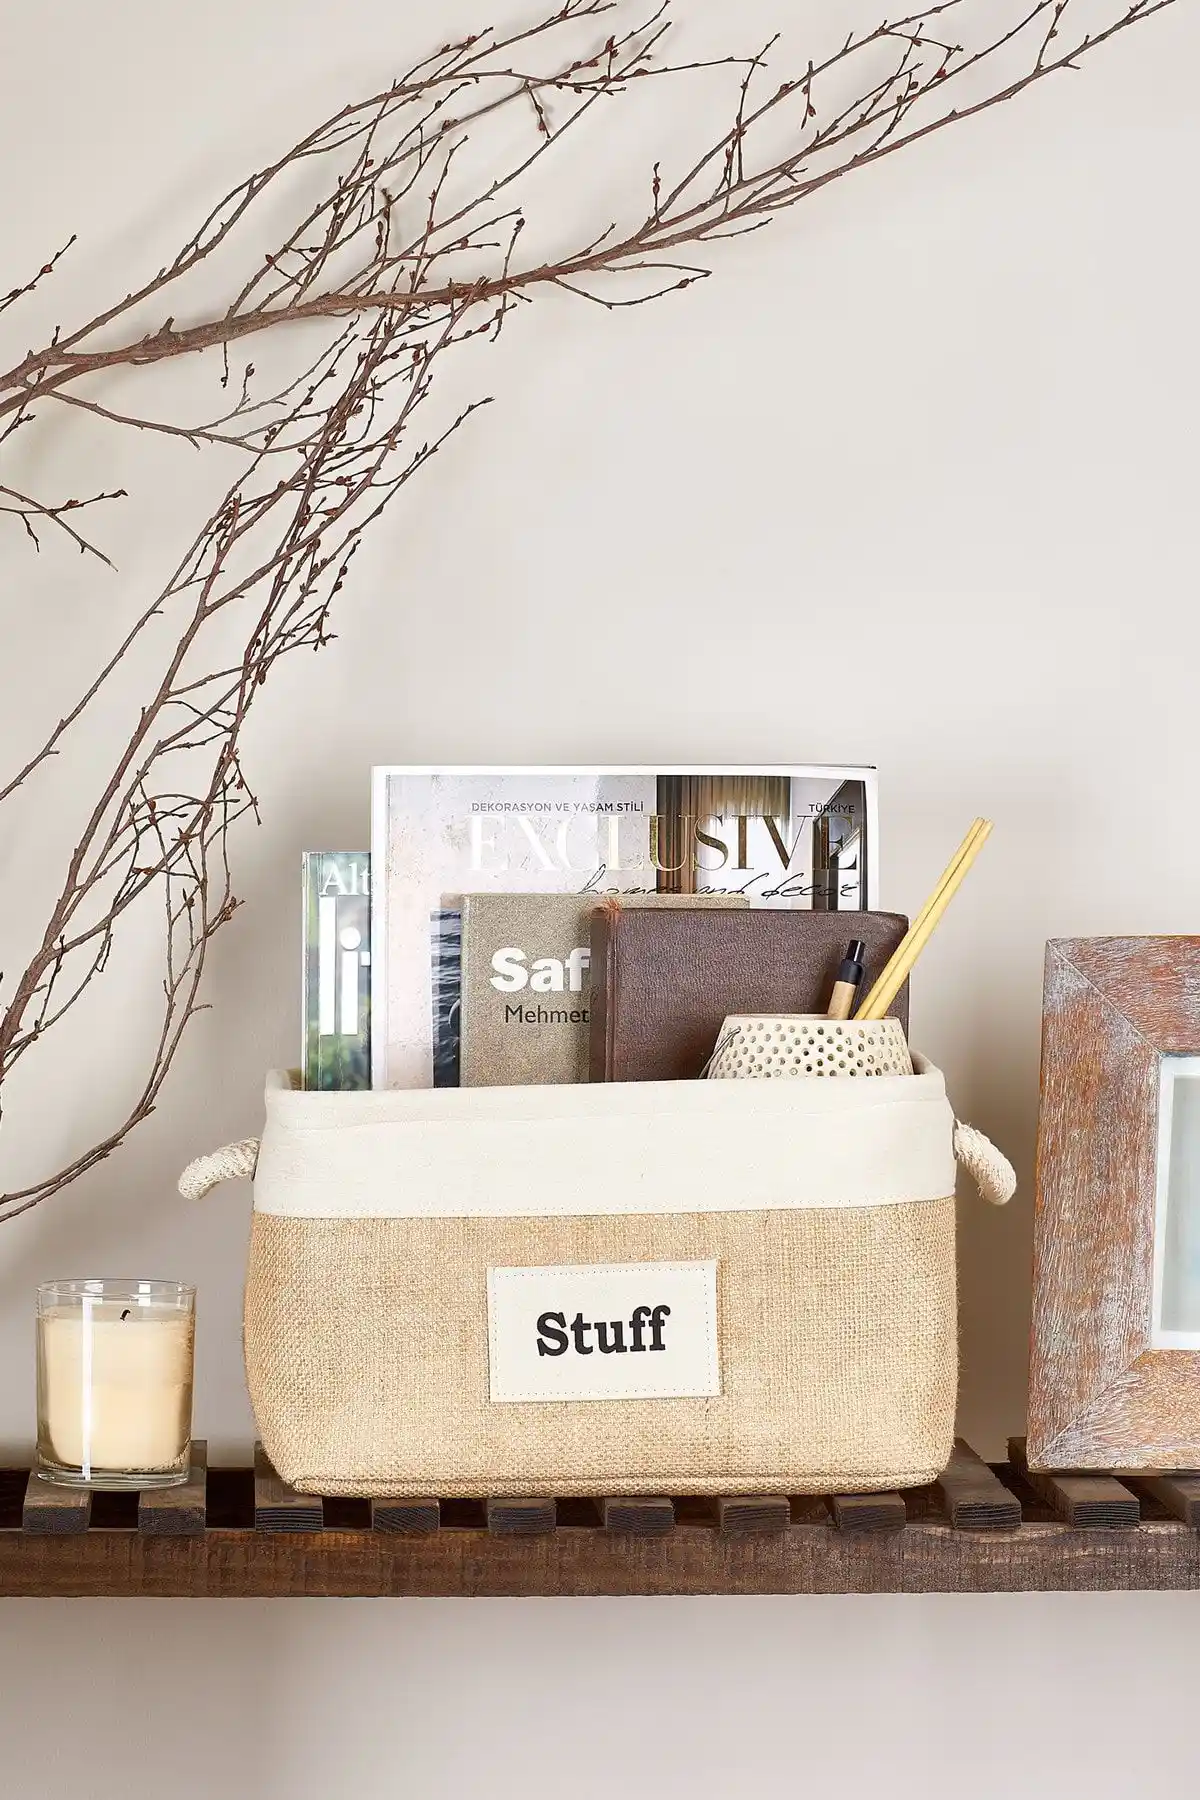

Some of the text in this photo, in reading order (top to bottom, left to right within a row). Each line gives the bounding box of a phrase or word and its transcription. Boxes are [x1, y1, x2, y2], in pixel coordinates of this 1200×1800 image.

[471, 802, 552, 812] DEKORASYON
[555, 802, 569, 812] VE
[573, 802, 613, 813] YAŞAM
[466, 813, 857, 872] EXCLUSIVE
[505, 1004, 590, 1024] Mehmet
[536, 1304, 671, 1357] Stuff
